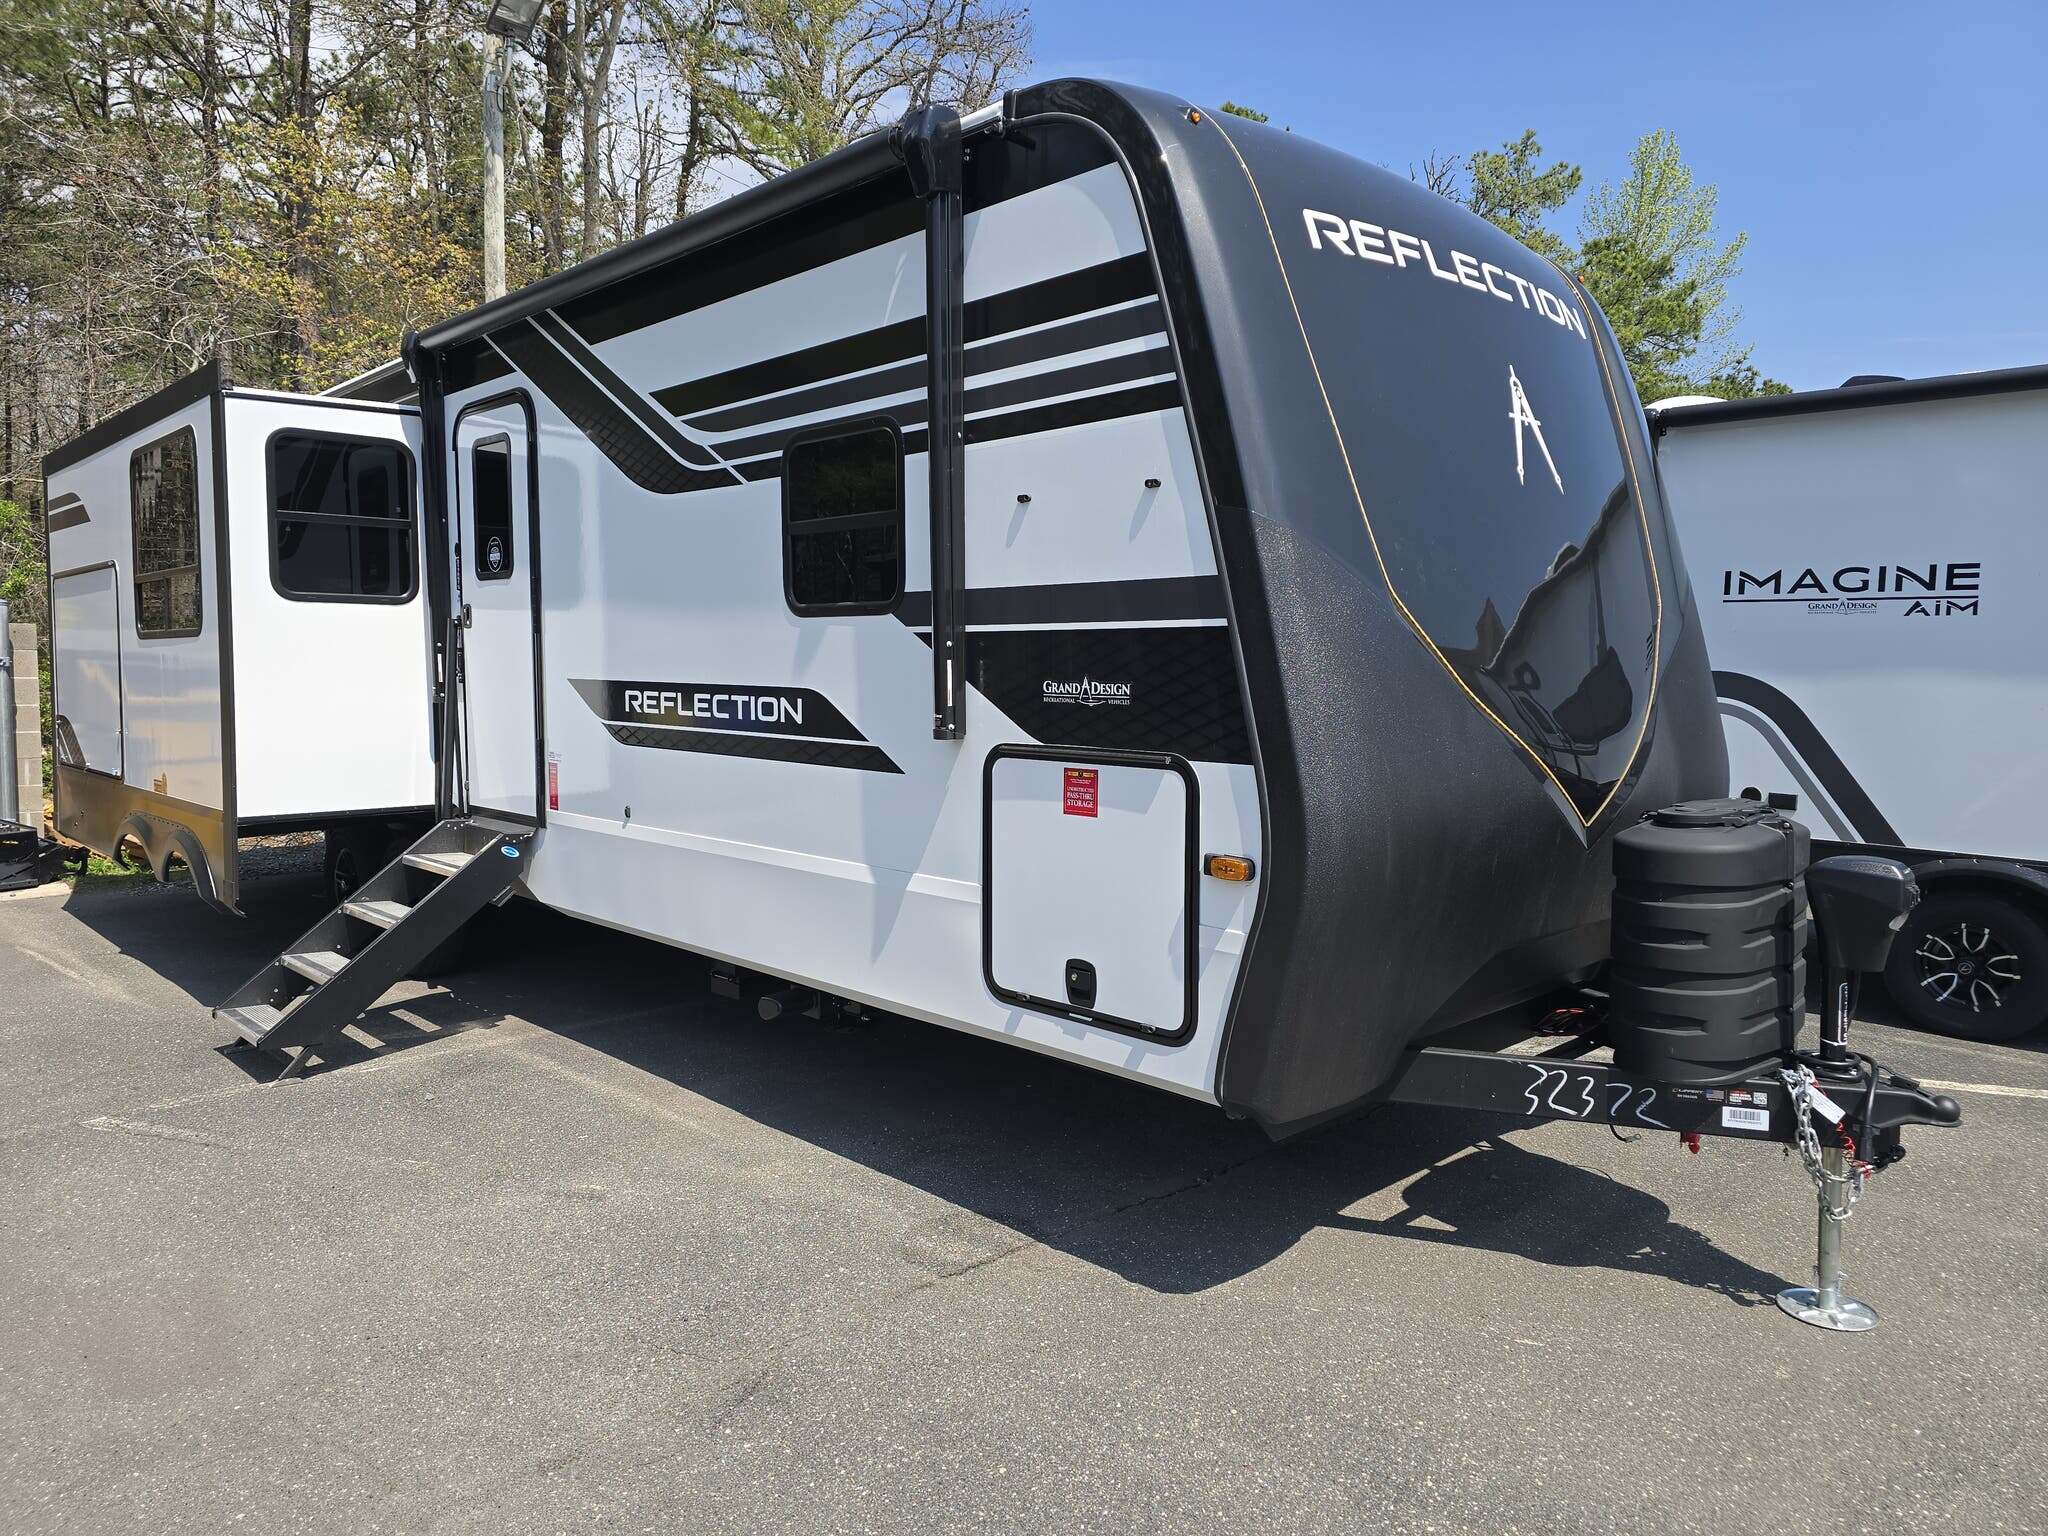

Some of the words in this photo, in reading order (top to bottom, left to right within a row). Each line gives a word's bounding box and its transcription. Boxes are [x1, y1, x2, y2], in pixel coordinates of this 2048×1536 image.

[1302, 208, 1588, 340] REFLECTION
[1723, 562, 1981, 596] IMAGINE
[1807, 602, 1838, 610] GRAND
[1042, 680, 1081, 694] GRAND
[1090, 681, 1131, 696] DESIGN
[624, 690, 803, 725] REFLECTION
[1066, 799, 1095, 808] STORAGE
[1524, 1064, 1672, 1129] 32372
